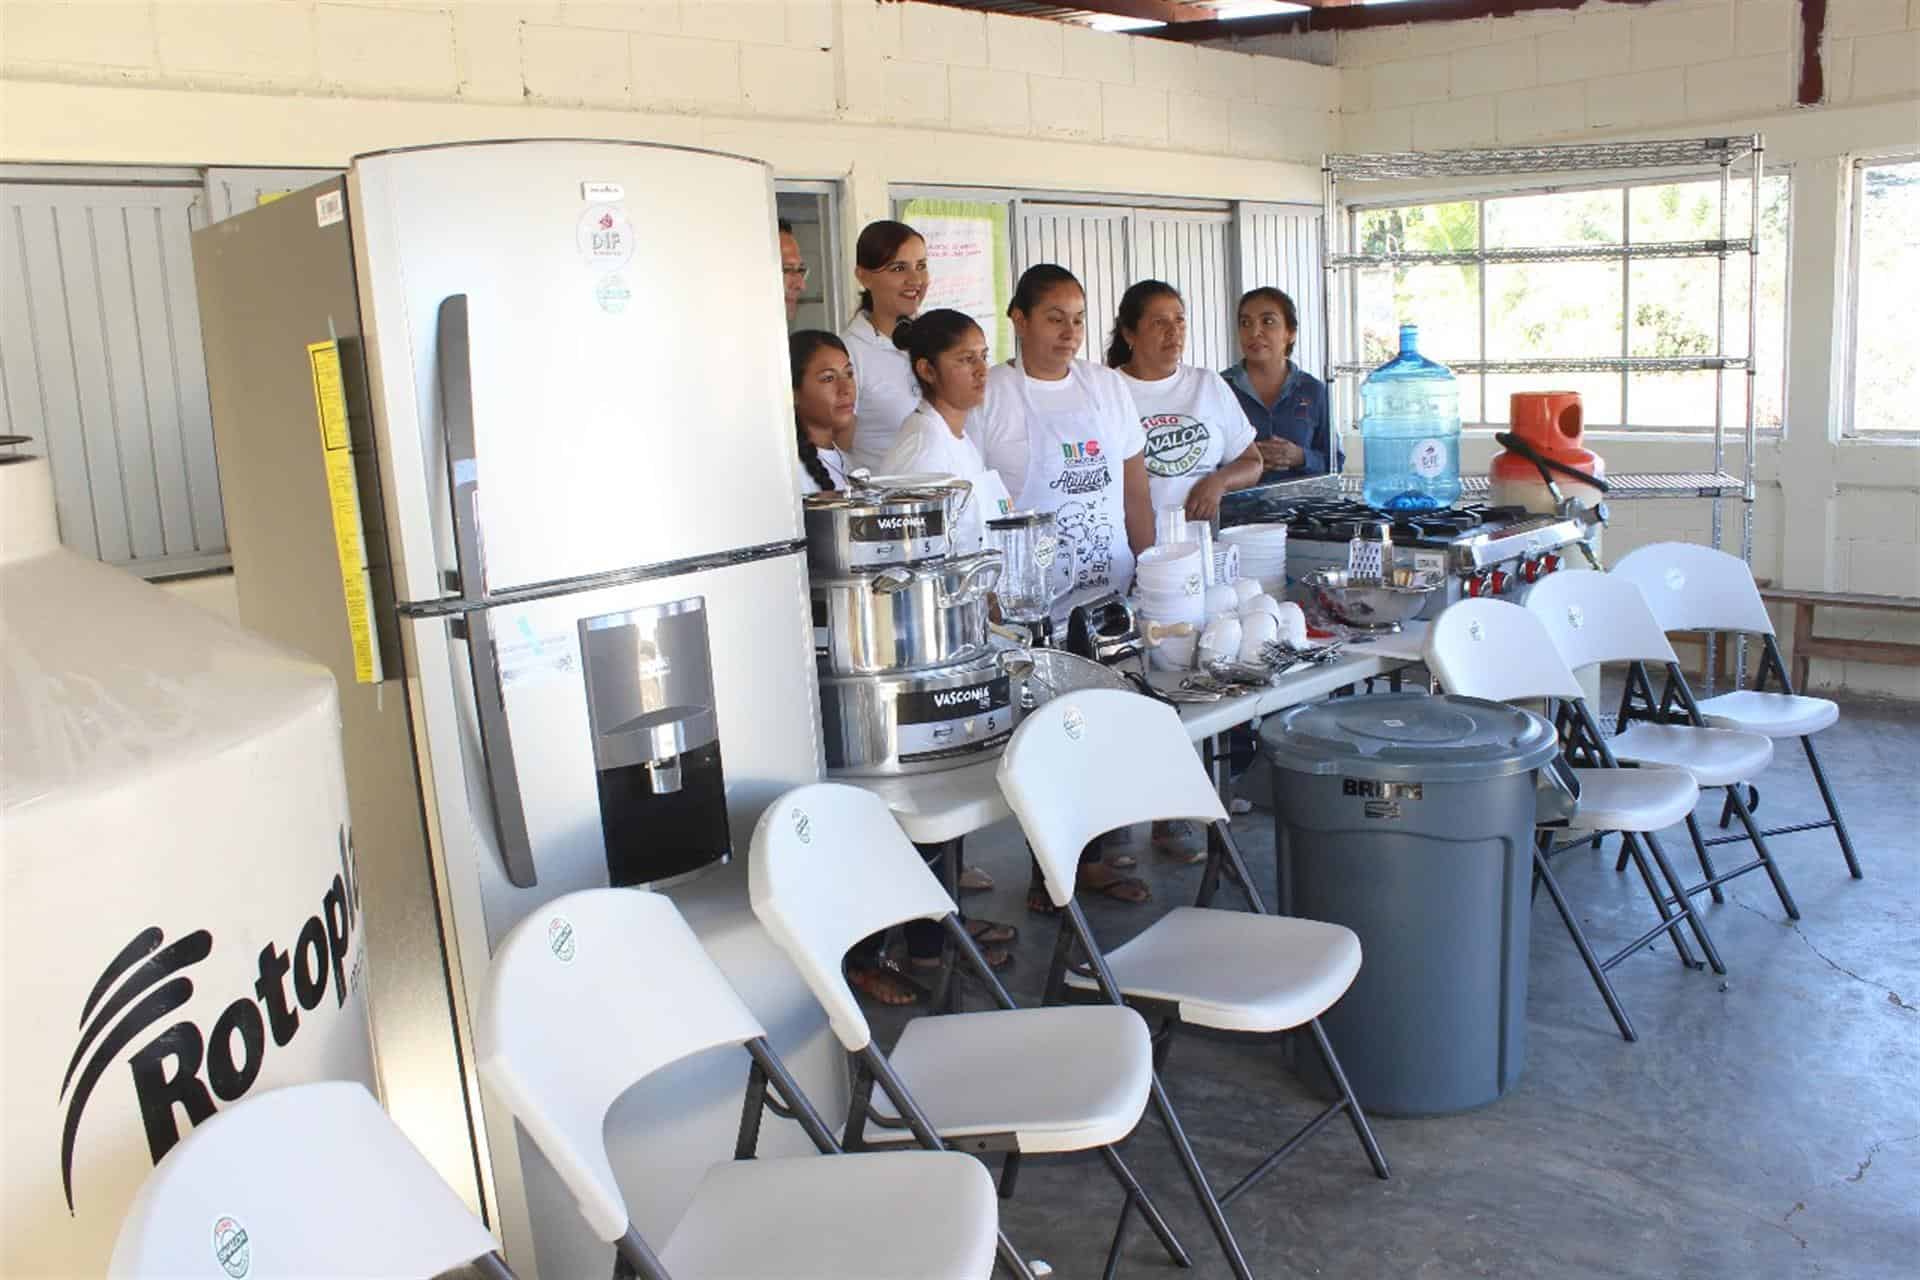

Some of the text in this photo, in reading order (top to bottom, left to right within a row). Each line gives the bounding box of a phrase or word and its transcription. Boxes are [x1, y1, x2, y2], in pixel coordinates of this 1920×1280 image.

[1148, 447, 1202, 473] CALIDAD
[933, 686, 990, 708] VASCONIA
[987, 717, 996, 731] 5
